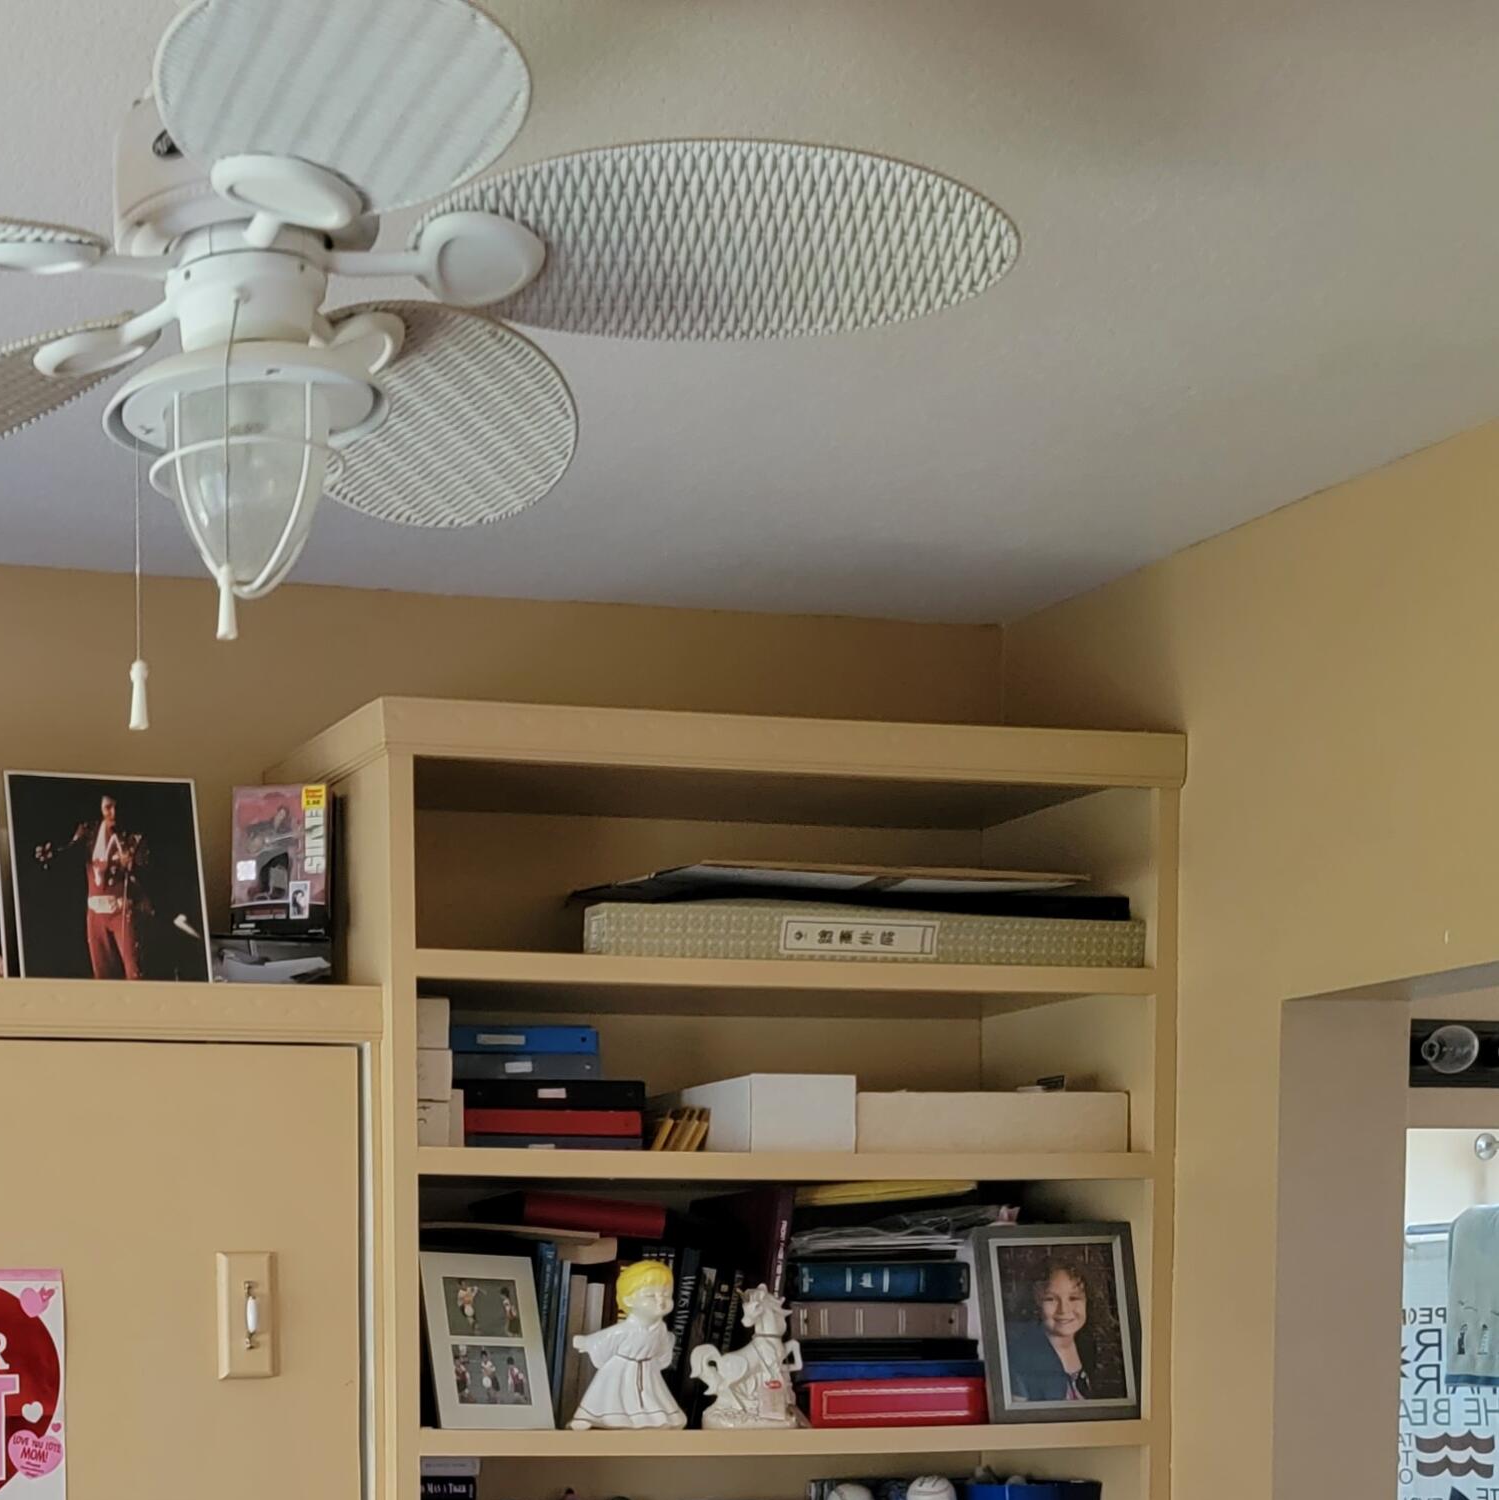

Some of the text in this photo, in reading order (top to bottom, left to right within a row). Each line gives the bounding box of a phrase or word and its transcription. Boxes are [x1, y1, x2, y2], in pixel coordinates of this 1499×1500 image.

[13, 1434, 30, 1446] LOVE
[32, 1440, 44, 1449] YOU
[20, 1447, 49, 1463] MOM!
